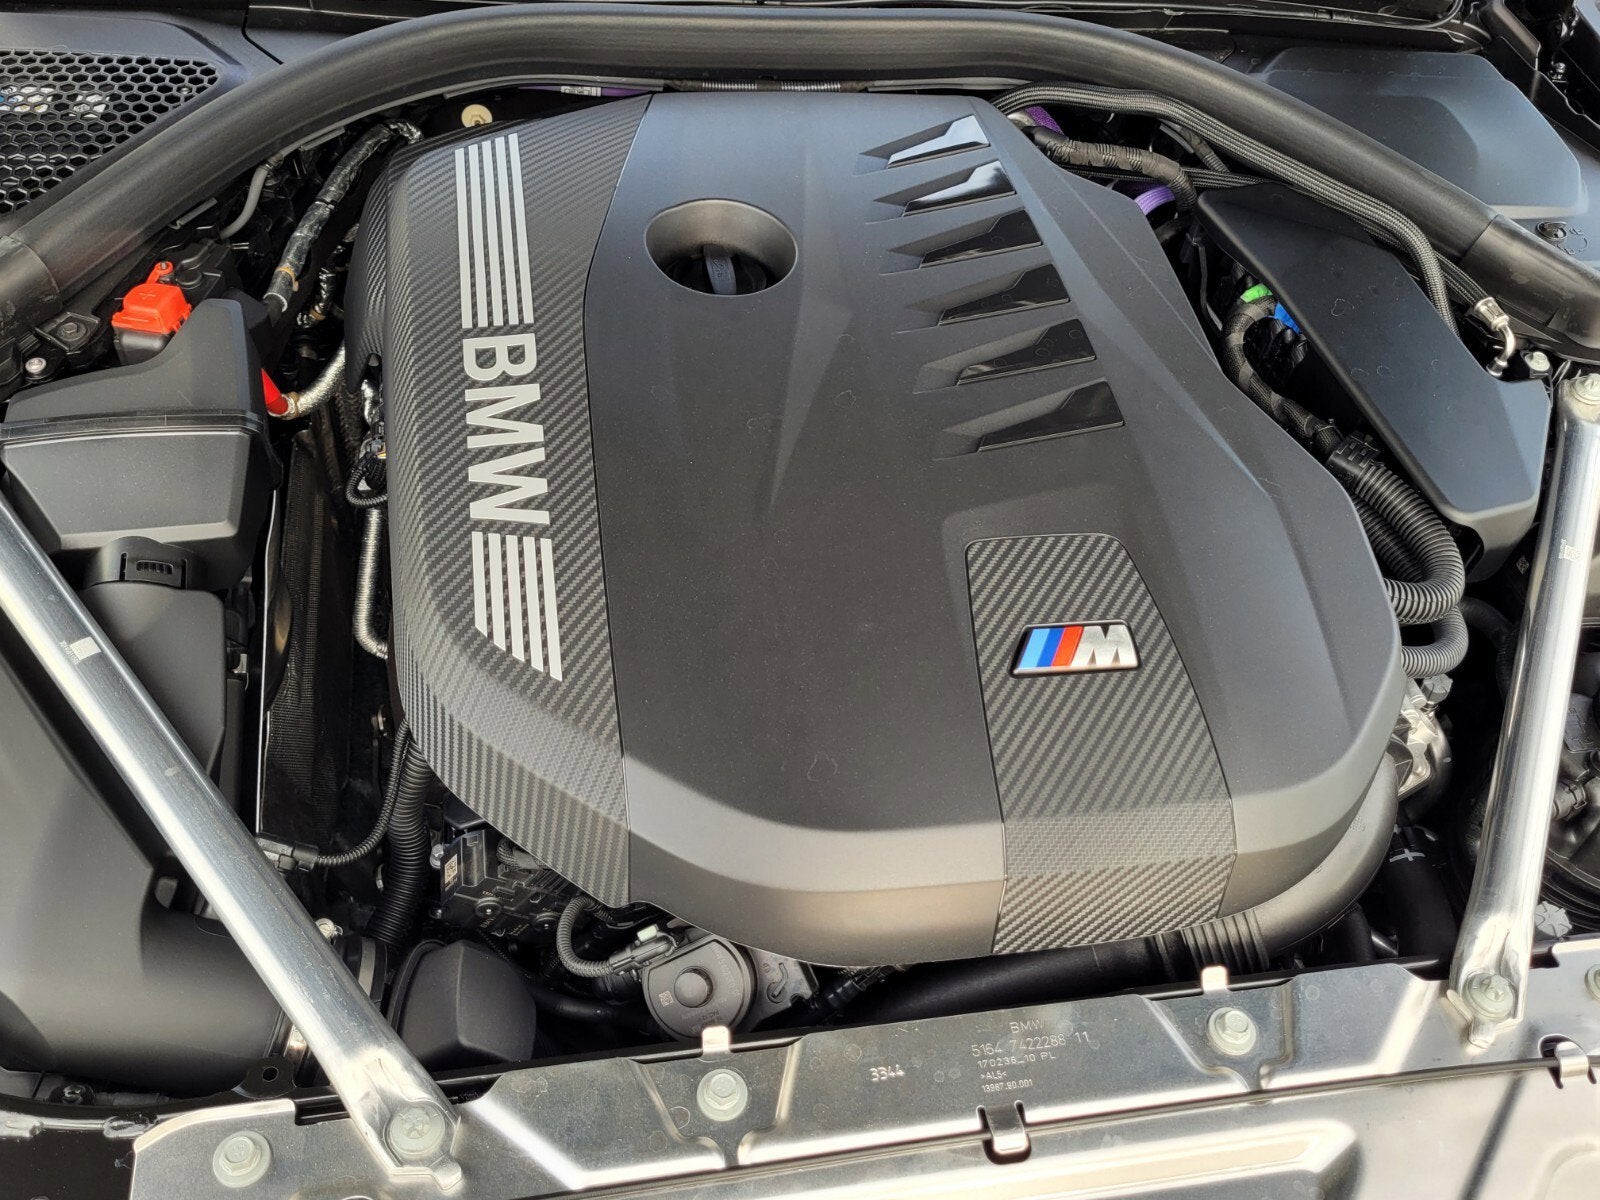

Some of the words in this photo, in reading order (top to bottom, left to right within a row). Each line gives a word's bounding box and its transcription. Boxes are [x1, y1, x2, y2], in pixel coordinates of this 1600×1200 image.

[461, 333, 550, 525] BMW
[1070, 625, 1138, 667] M
[1009, 1019, 1044, 1034] BMW
[971, 1041, 1003, 1057] 5164
[1009, 1034, 1067, 1053] 7422288
[869, 1064, 905, 1081] 3344
